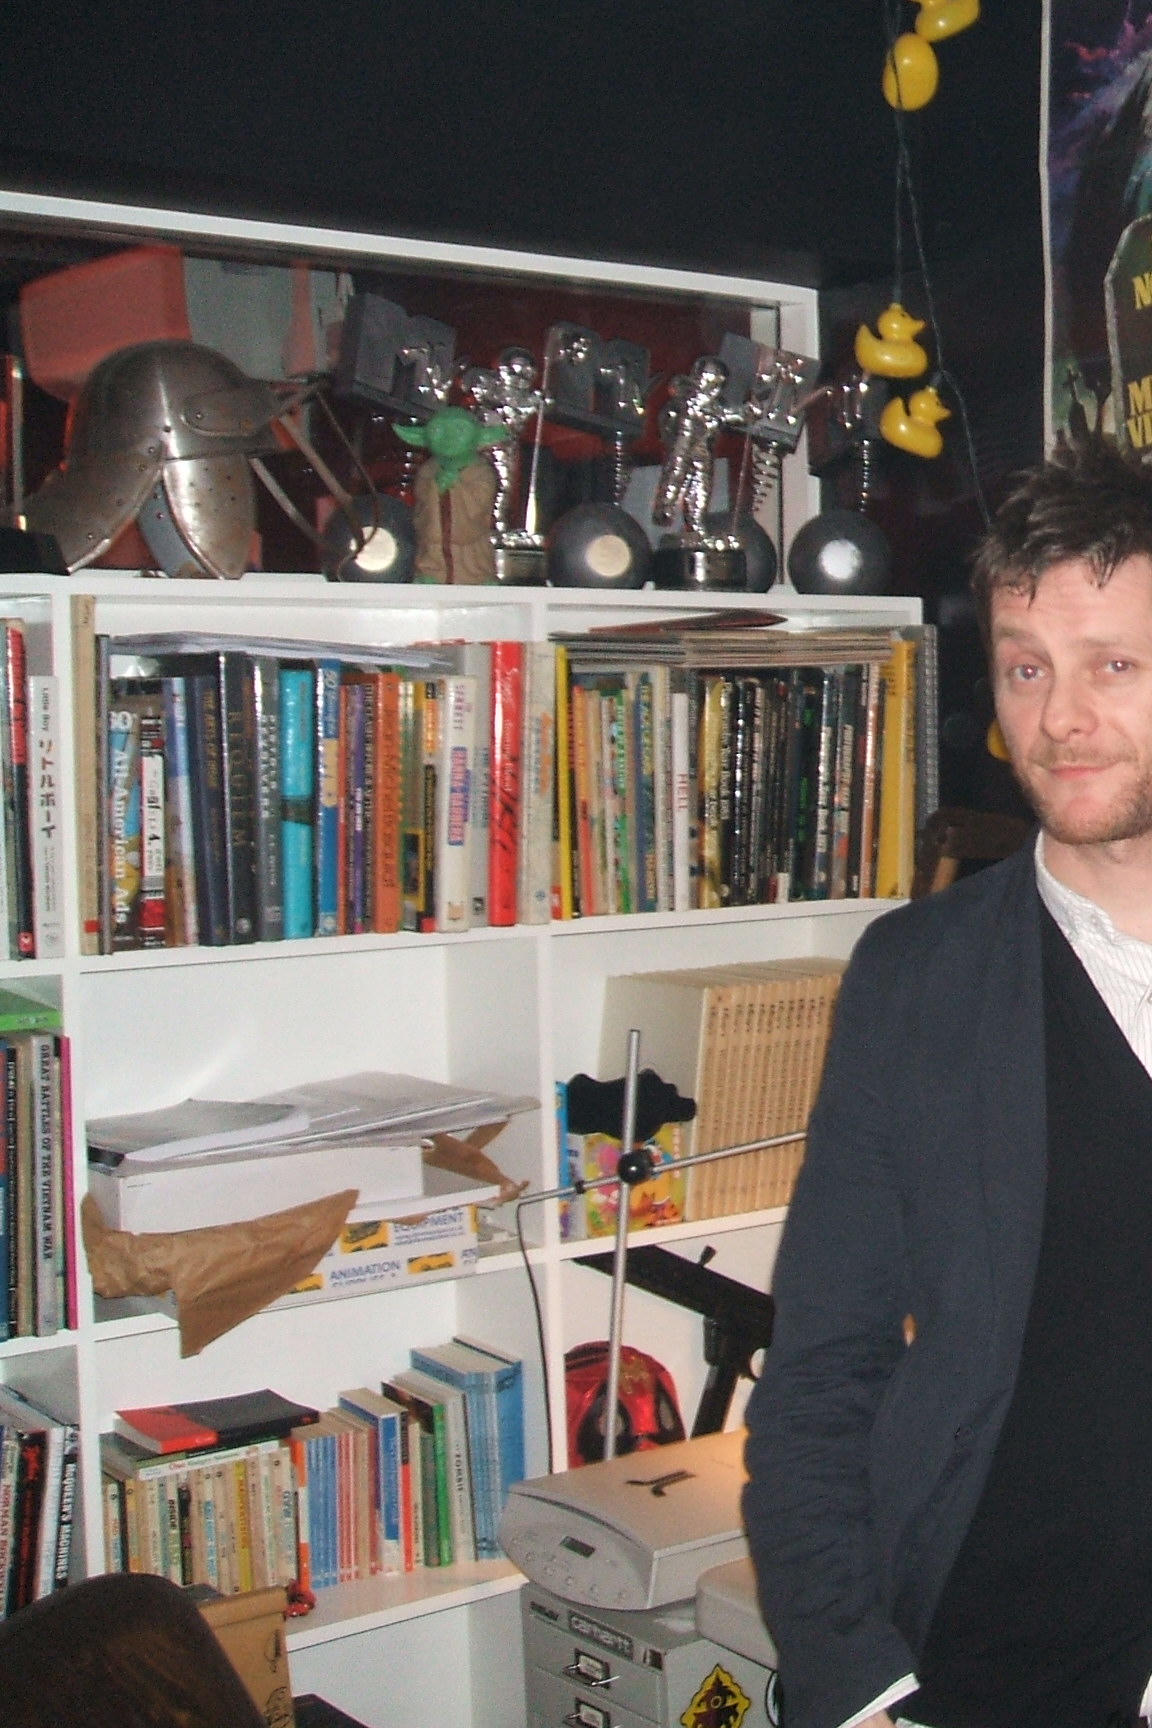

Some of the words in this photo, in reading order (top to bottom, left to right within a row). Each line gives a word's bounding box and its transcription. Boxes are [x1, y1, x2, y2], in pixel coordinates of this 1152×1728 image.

[40, 713, 51, 733] Boy
[114, 749, 129, 879] All-American
[114, 886, 130, 924] Ads
[41, 1044, 51, 1082] GREAT
[41, 1085, 52, 1134] BATTLES
[42, 1137, 52, 1150] OF
[42, 1154, 52, 1177] THE
[42, 1180, 53, 1232] VIETNAM
[43, 1235, 53, 1260] WAR
[330, 1260, 401, 1282] ANIMATION
[60, 1462, 77, 1523] McQUEEN'S
[56, 1524, 73, 1580] MACHINES
